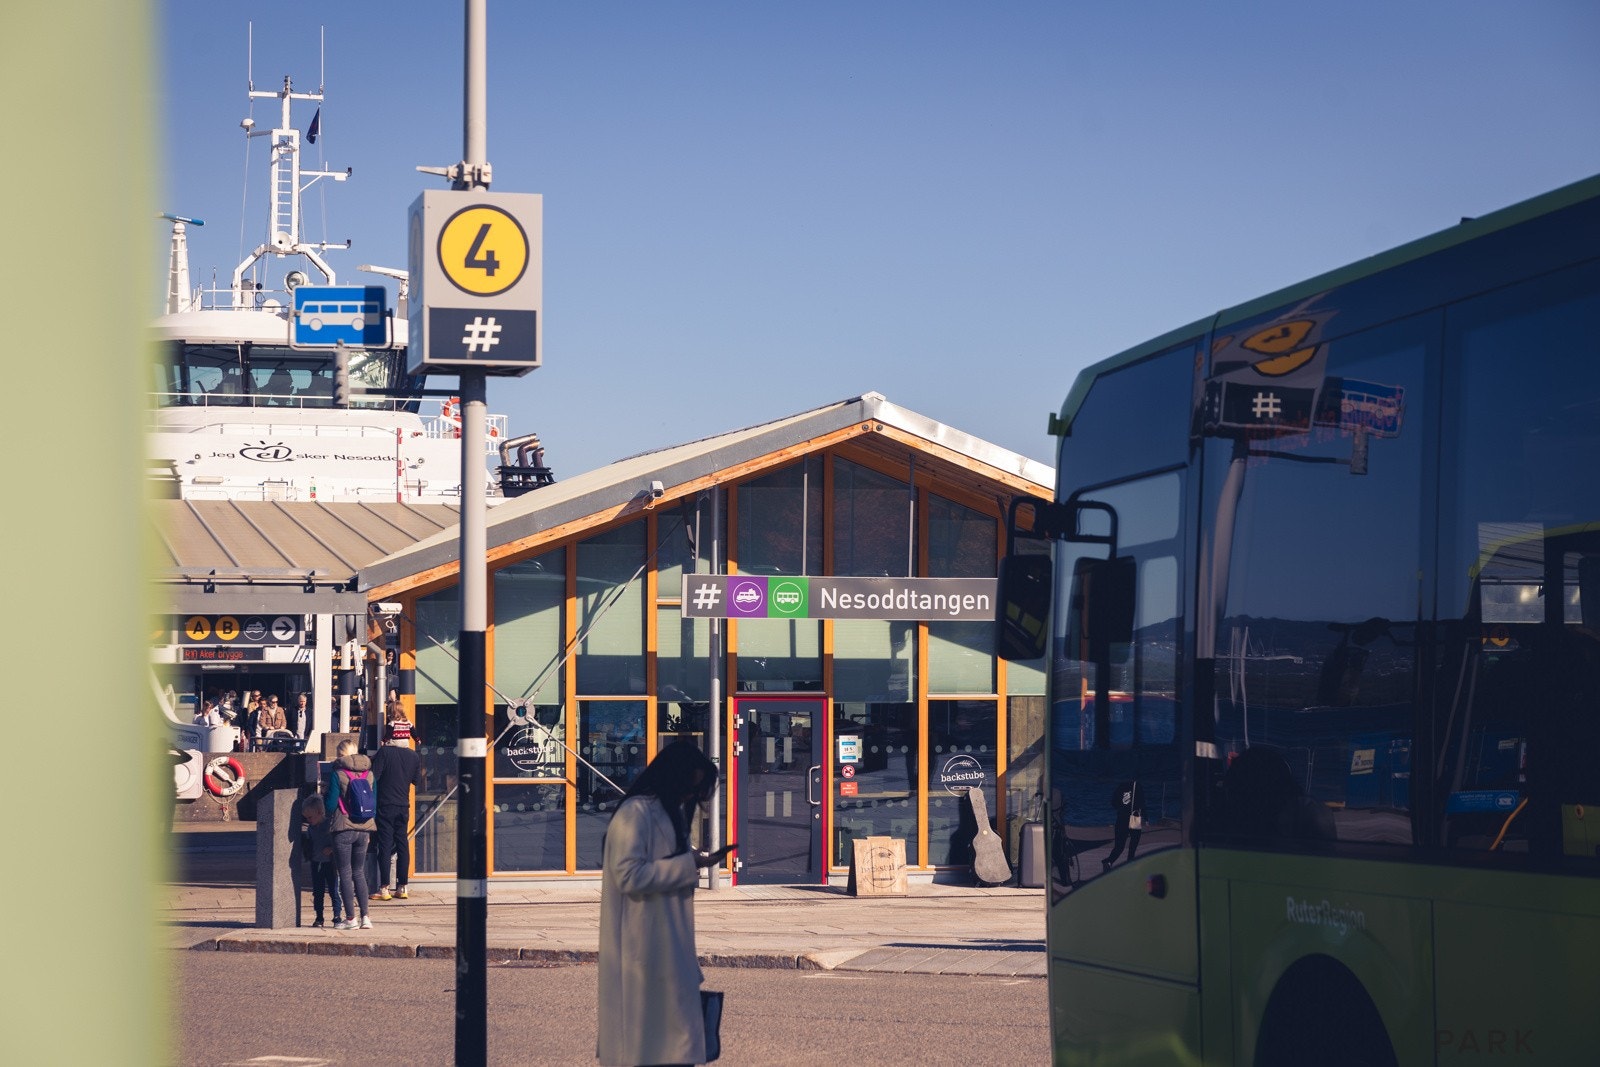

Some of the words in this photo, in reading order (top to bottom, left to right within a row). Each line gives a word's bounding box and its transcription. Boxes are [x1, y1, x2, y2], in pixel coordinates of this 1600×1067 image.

[464, 223, 500, 277] 4
[462, 317, 502, 352] #
[208, 451, 236, 460] Jeg
[821, 587, 990, 615] Nesoddtangen
[193, 621, 204, 634] A
[223, 621, 233, 634] B
[941, 771, 985, 783] backstube
[1286, 896, 1366, 936] RuterRegion
